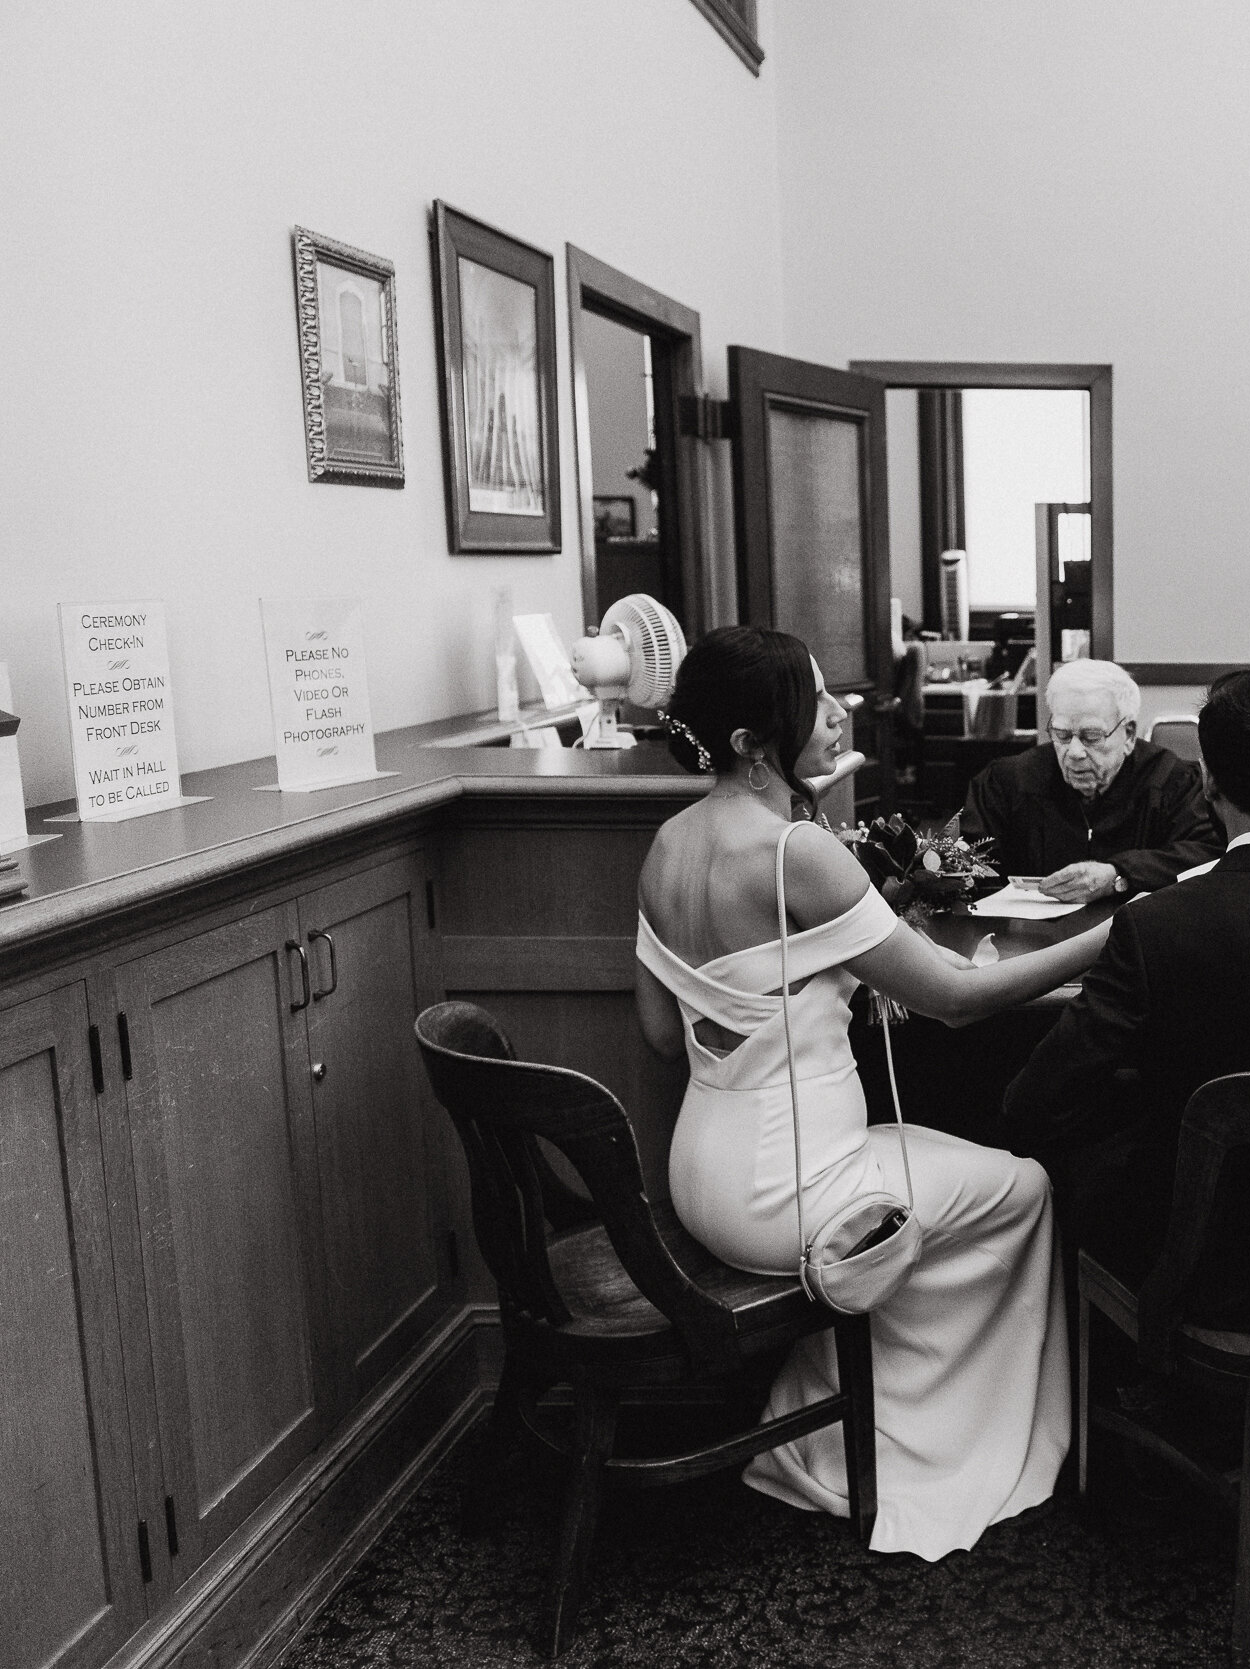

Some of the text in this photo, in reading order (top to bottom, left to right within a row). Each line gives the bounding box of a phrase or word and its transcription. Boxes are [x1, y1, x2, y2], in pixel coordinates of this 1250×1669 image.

[81, 614, 147, 629] CEREMONY
[89, 636, 144, 651] CHECK-IN
[286, 647, 349, 662] PLEASE NO
[73, 677, 164, 697] PLEASE OBTAIN
[294, 686, 349, 701] VIDEO OR
[79, 698, 164, 719] NUMBER FROM
[306, 707, 342, 720] FLASH
[86, 720, 161, 741] FRONT DESK
[284, 724, 365, 743] PHOTOGRAPHY
[89, 761, 166, 784] WAIT IN HALL
[89, 781, 169, 807] TO BE CALLED
